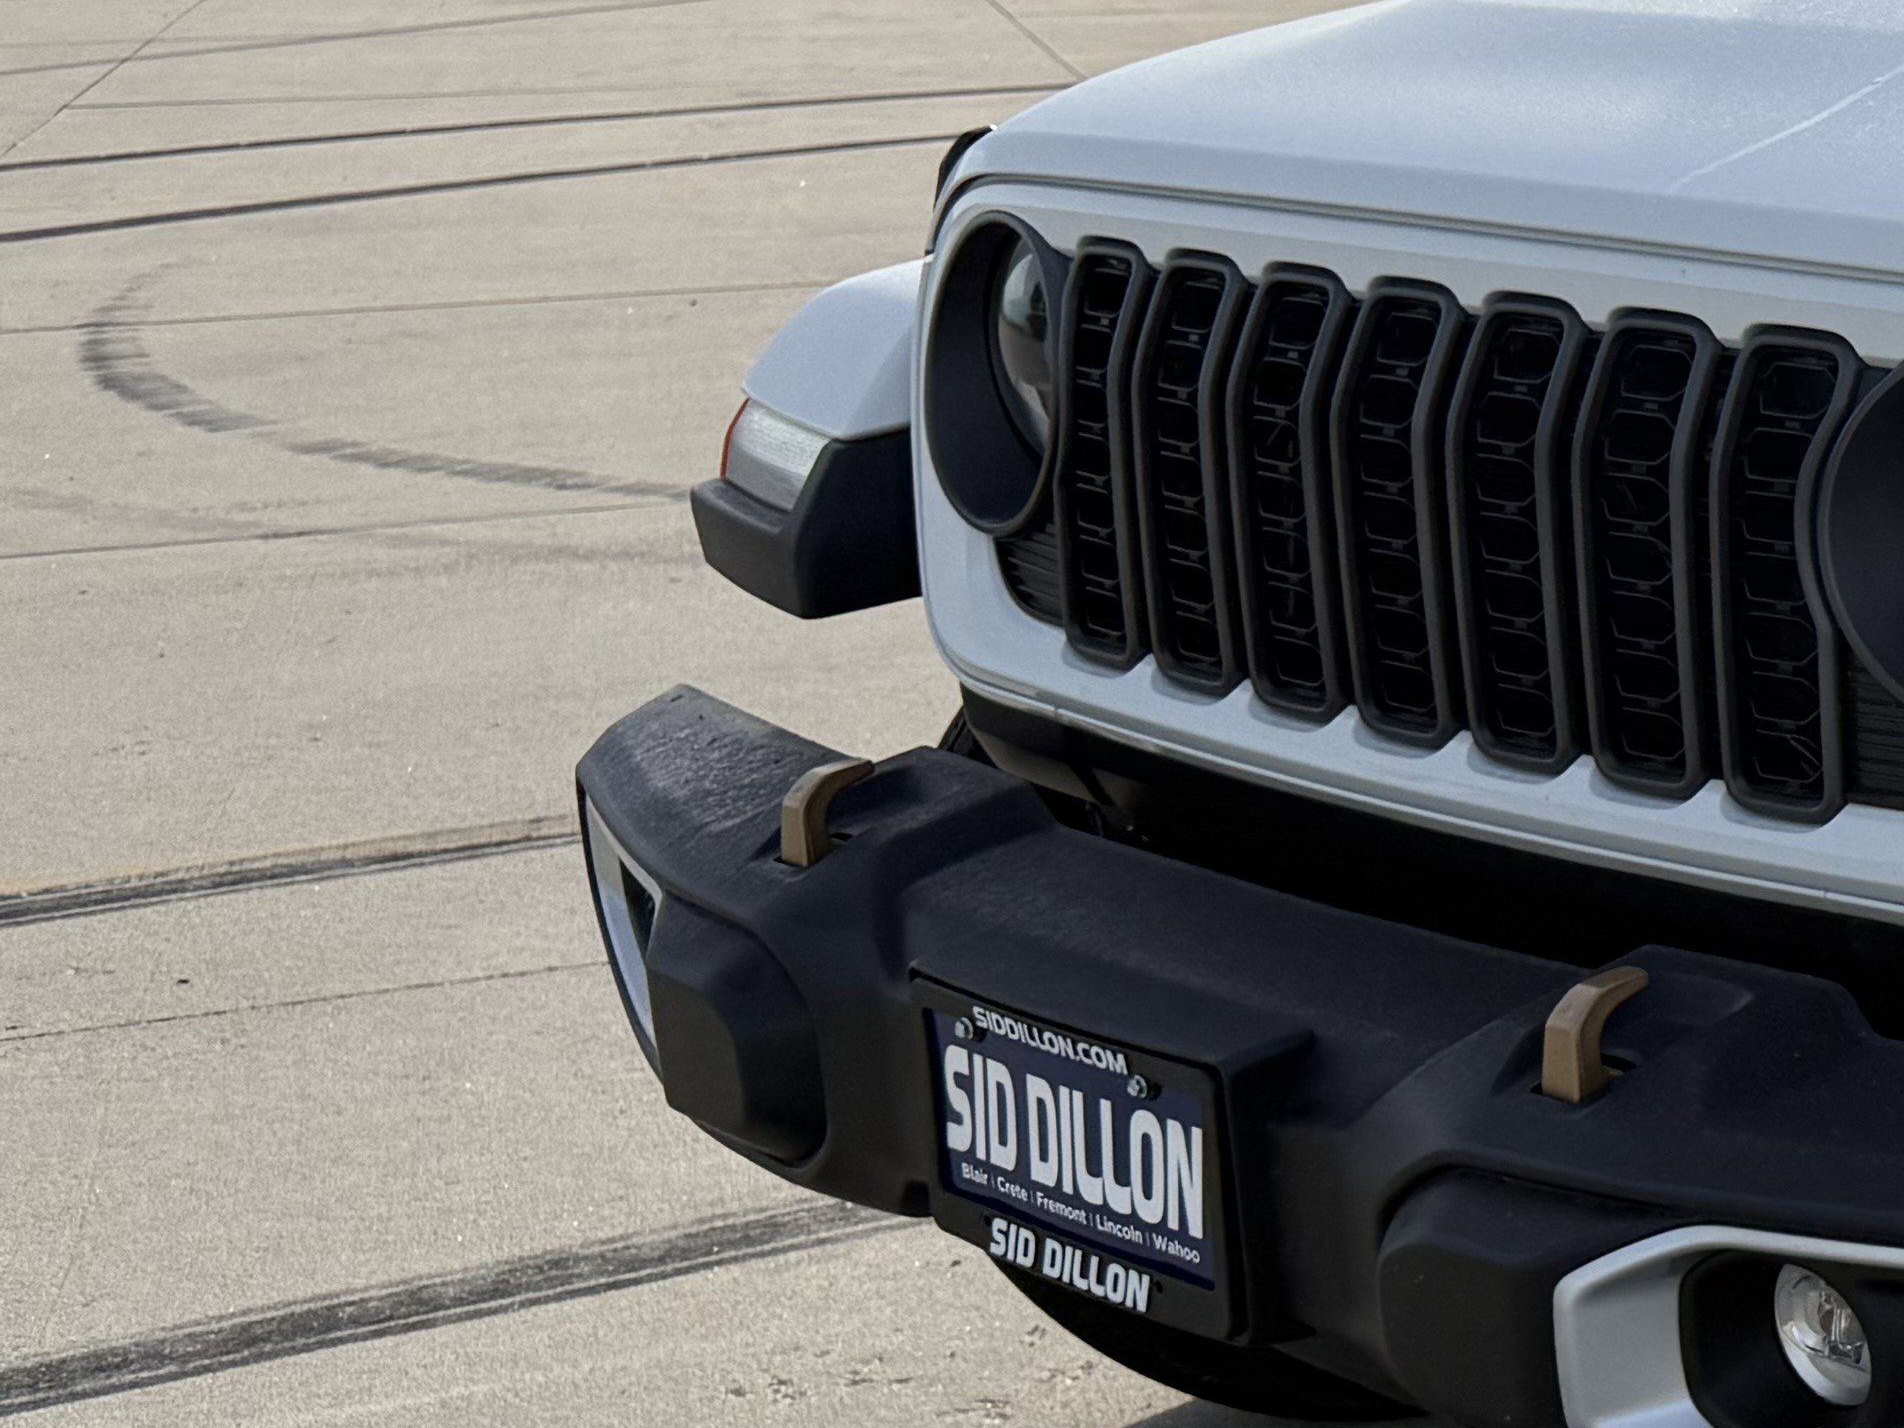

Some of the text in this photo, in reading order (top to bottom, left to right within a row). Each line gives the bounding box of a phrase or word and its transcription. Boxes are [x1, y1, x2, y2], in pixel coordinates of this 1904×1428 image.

[972, 1005, 1128, 1076] SIDDILLON.COM
[944, 1044, 1204, 1239] SID DILLON
[961, 1162, 1200, 1264] Blair Crete Fremont Lincoln Wahoo
[989, 1217, 1150, 1314] SID DILLON
